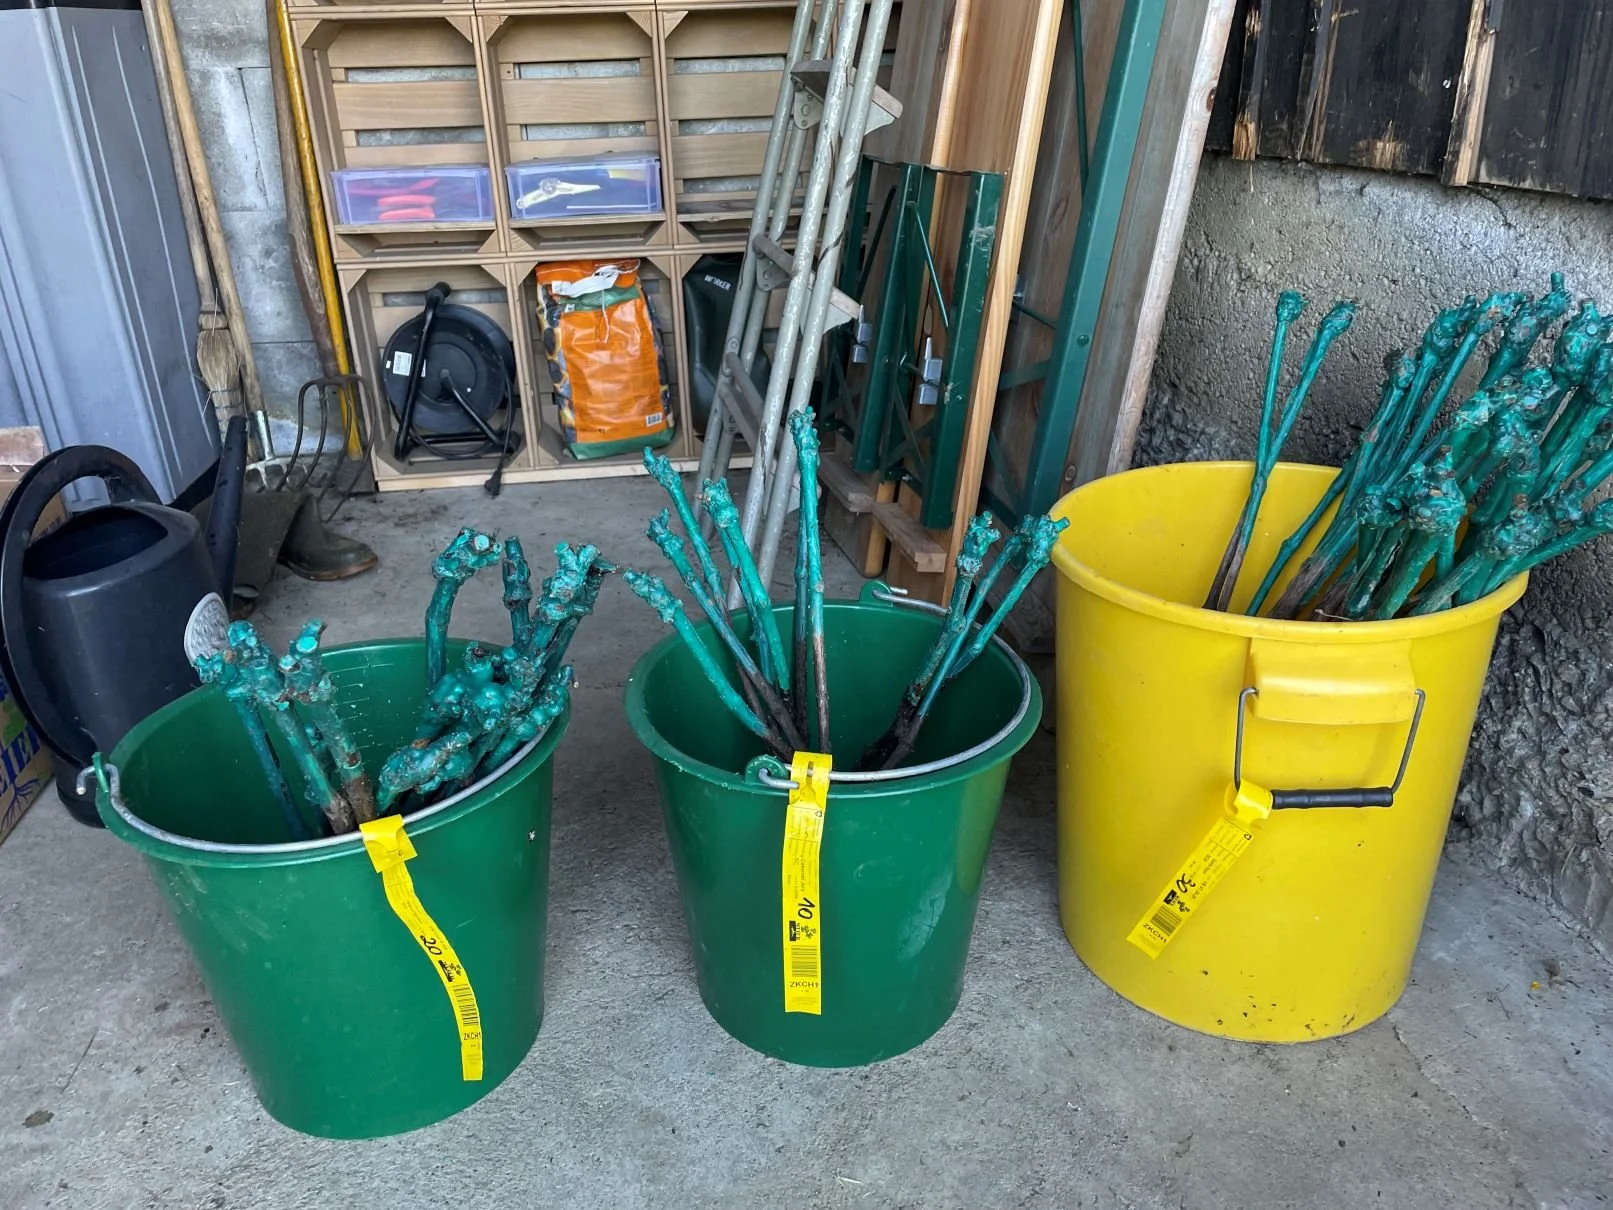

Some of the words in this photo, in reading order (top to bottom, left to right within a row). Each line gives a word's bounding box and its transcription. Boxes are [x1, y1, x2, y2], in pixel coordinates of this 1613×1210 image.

[1176, 873, 1196, 893] 30
[798, 897, 816, 920] 10
[1143, 923, 1168, 943] ZKCH1
[420, 935, 443, 956] 20
